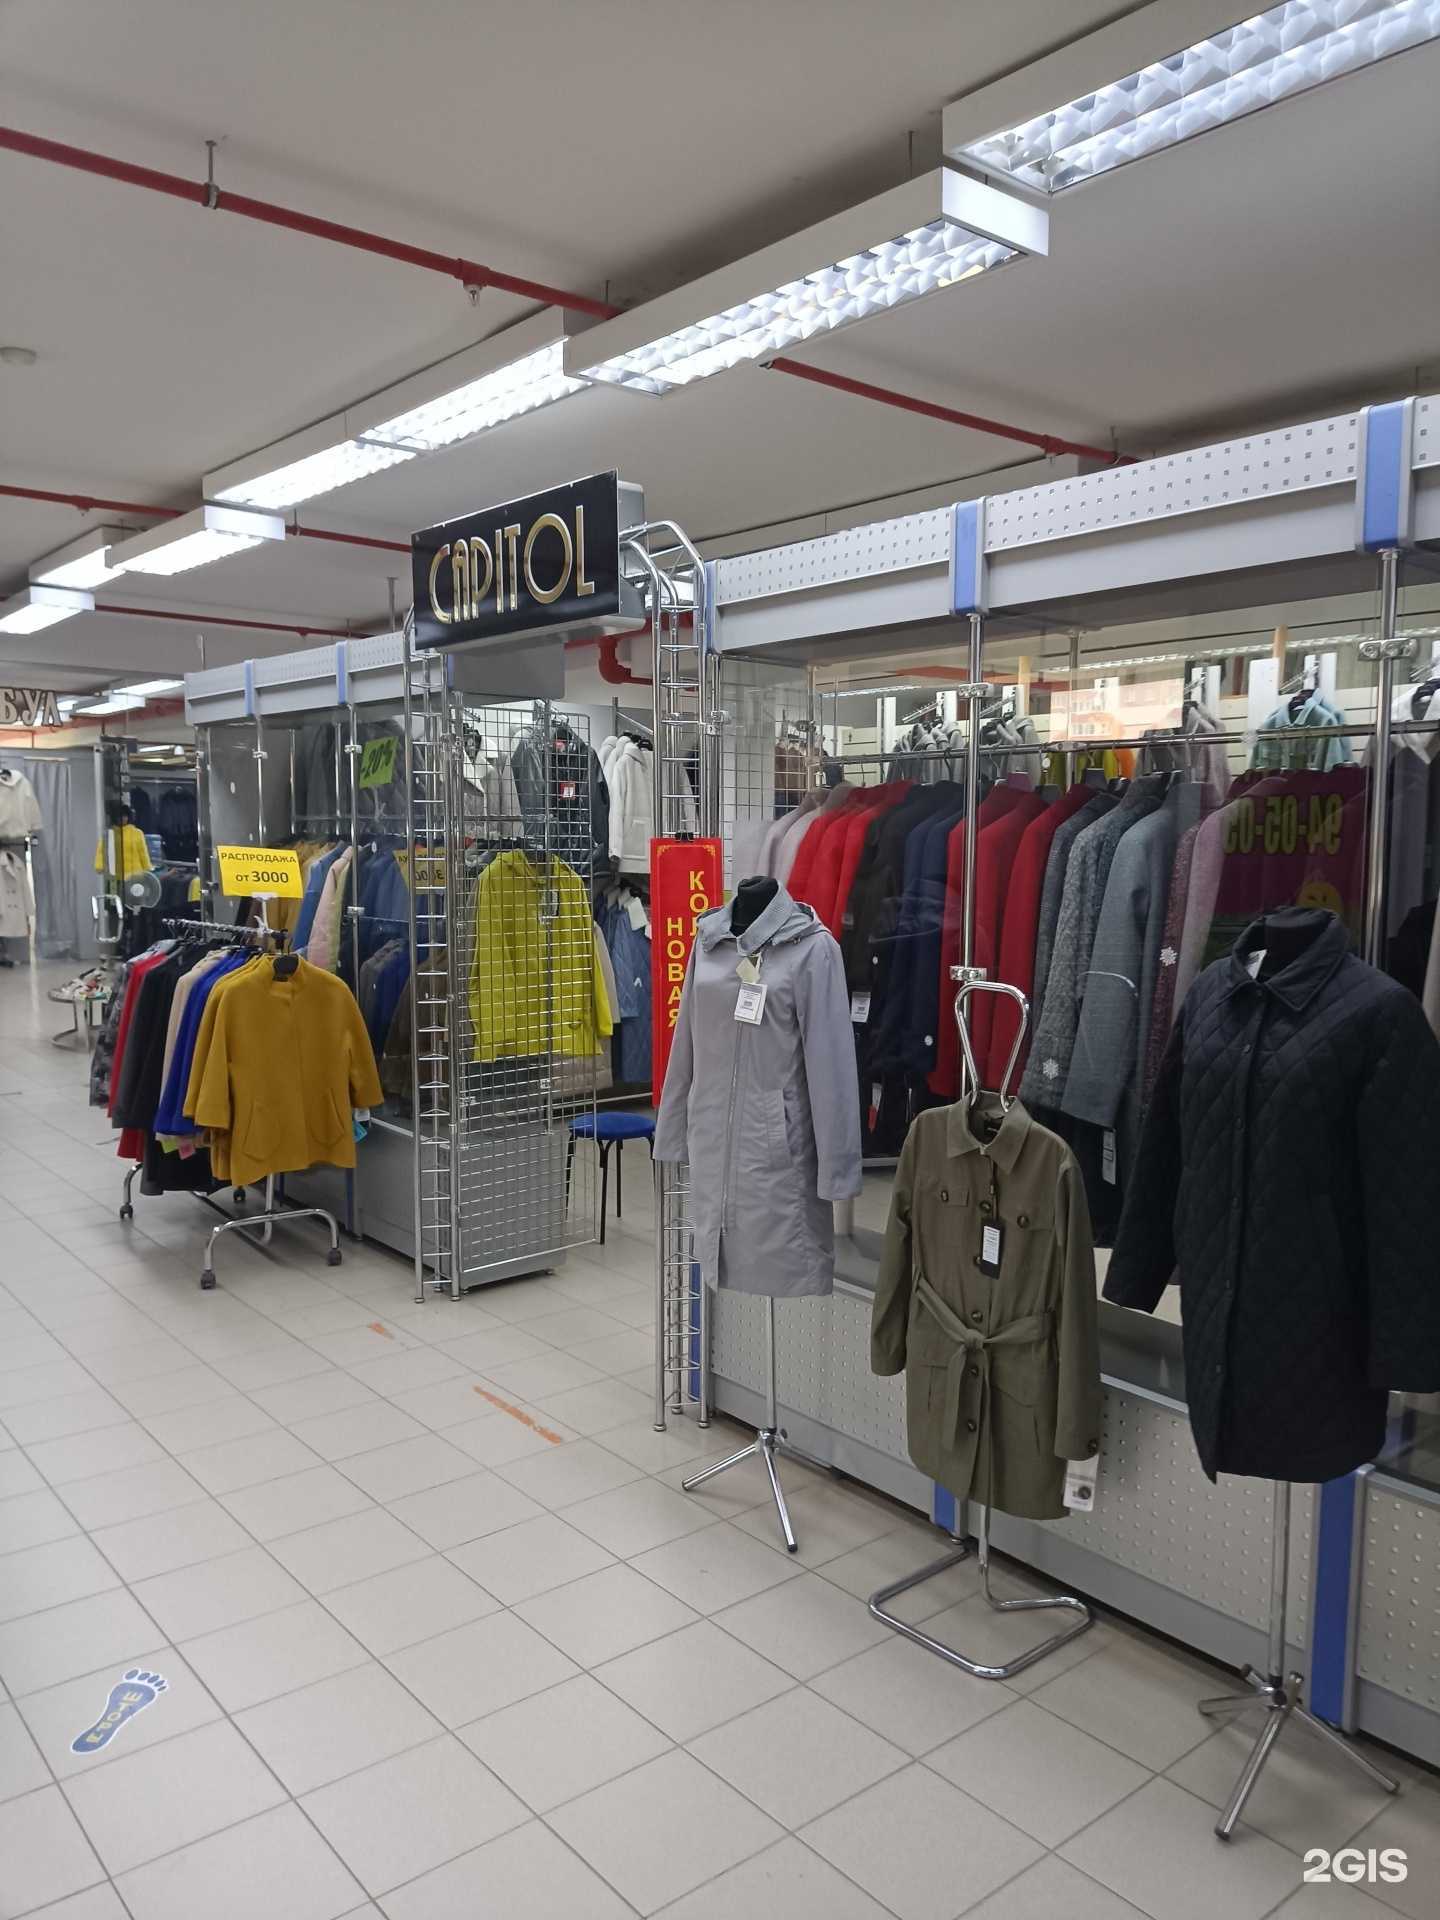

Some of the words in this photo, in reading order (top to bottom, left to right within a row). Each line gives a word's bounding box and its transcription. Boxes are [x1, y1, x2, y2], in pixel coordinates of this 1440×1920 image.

[429, 505, 595, 624] CAPITOL
[221, 852, 297, 863] РАСПРОДАЖА
[235, 873, 249, 882] от
[251, 870, 289, 884] 3000
[666, 917, 686, 1028] НОВАЯ
